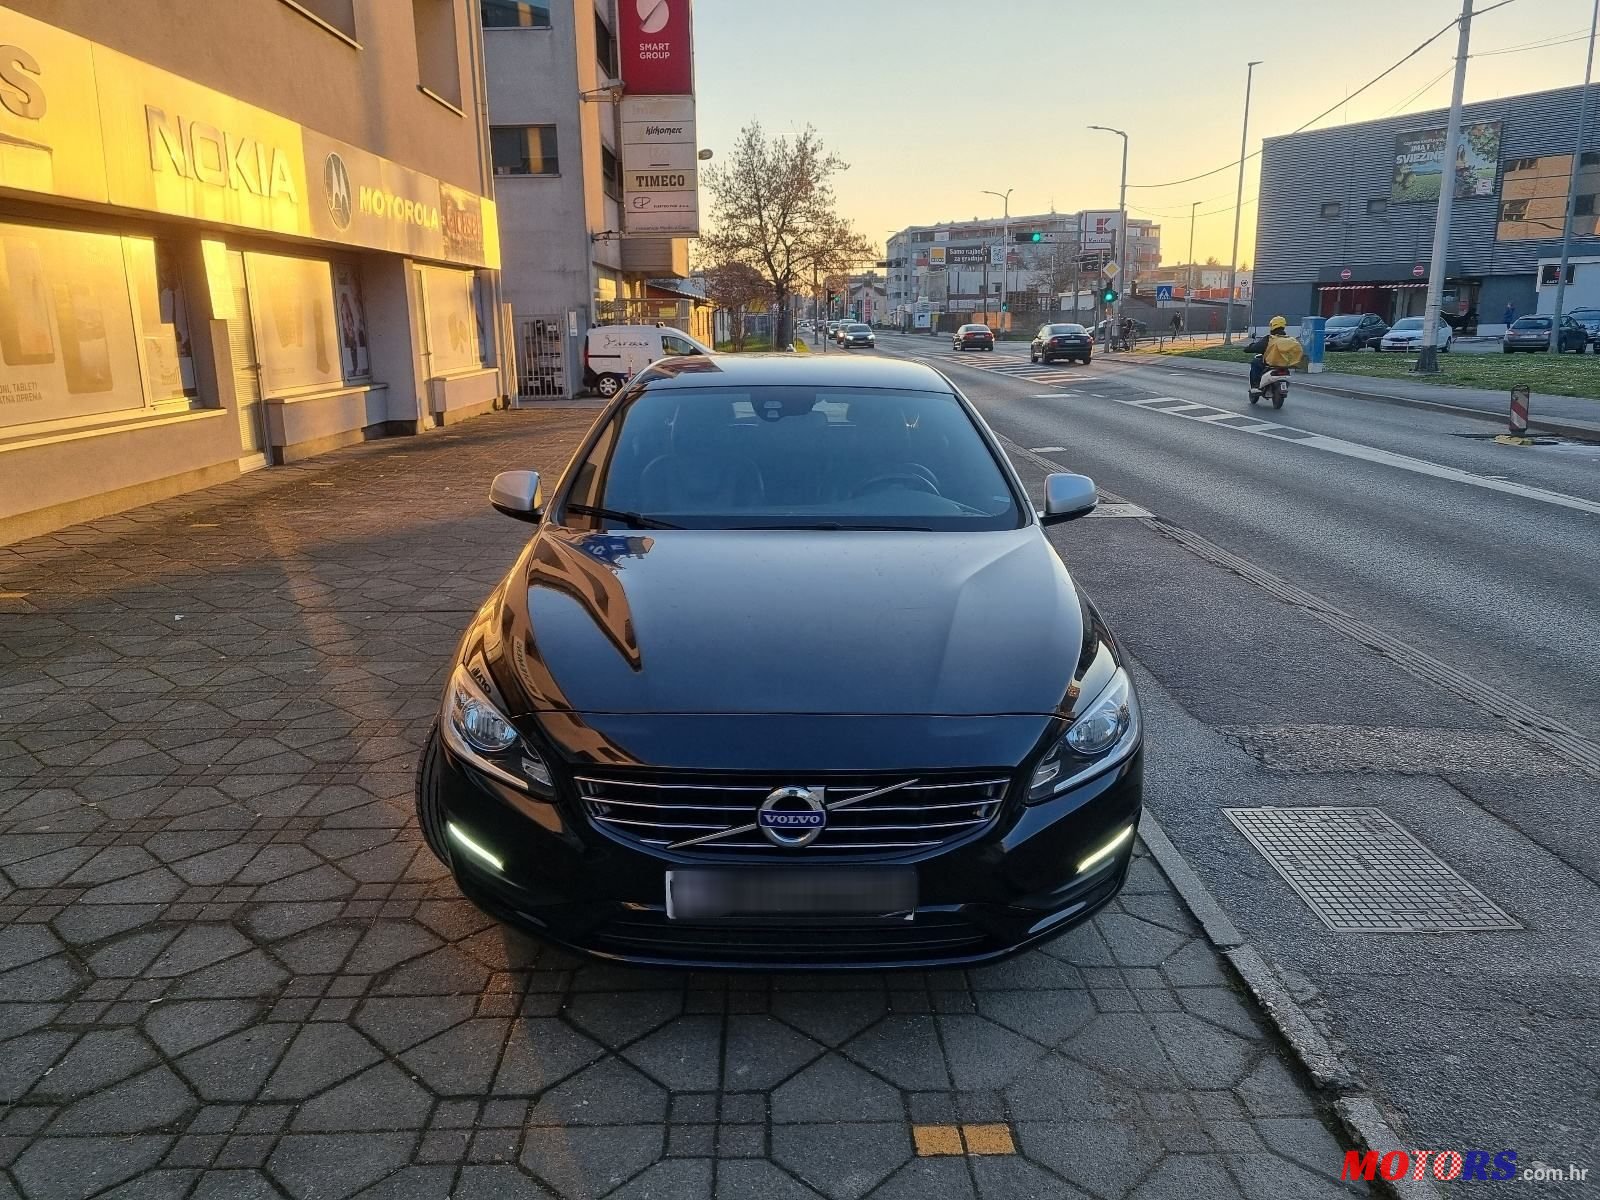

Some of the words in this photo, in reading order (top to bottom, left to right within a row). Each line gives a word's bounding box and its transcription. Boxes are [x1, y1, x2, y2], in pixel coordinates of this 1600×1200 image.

[639, 43, 670, 51] SMART
[144, 104, 298, 204] NOKIA
[635, 175, 685, 187] TIMECO
[359, 185, 439, 231] MOTOROLA
[763, 815, 820, 824] VOLVO
